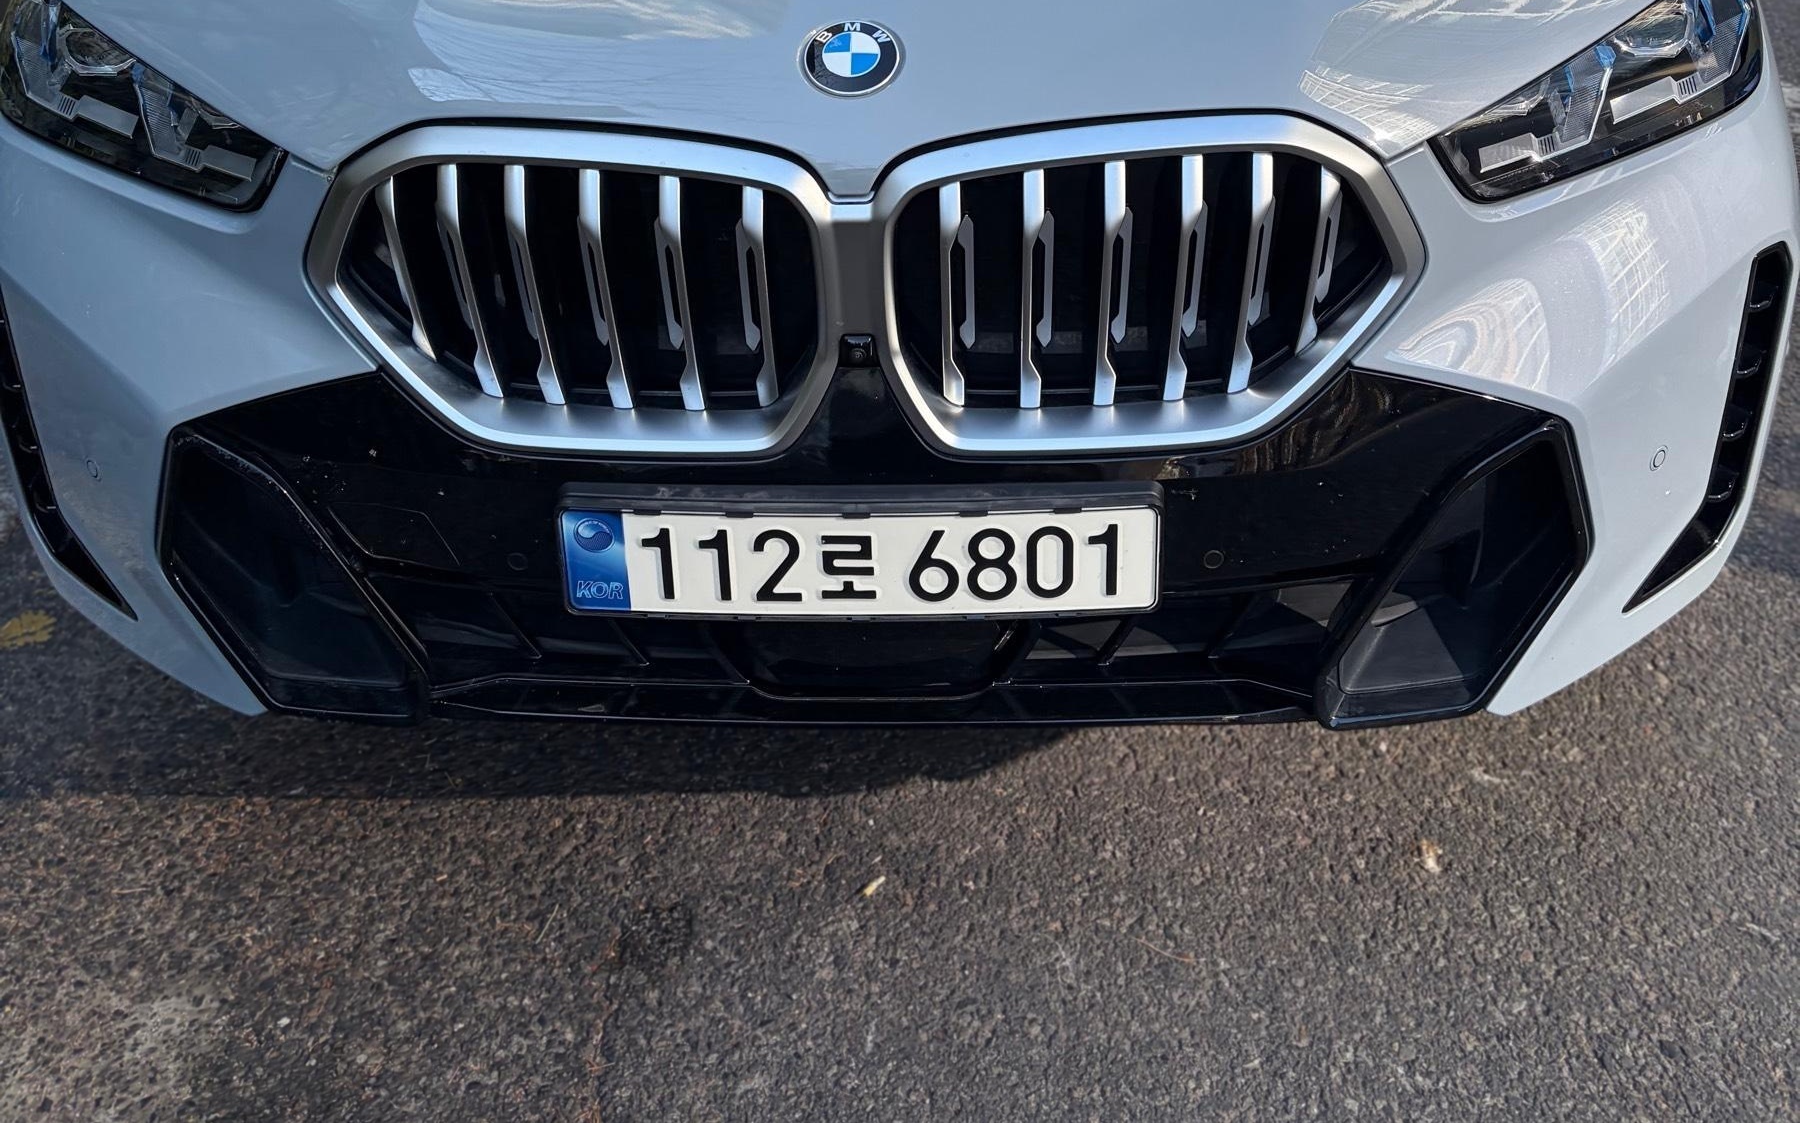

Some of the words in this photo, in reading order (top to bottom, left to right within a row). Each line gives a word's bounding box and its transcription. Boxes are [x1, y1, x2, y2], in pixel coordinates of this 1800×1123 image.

[815, 22, 891, 44] BMW
[641, 526, 877, 602] 112로
[908, 523, 1120, 602] 6801
[576, 580, 624, 600] KOR
